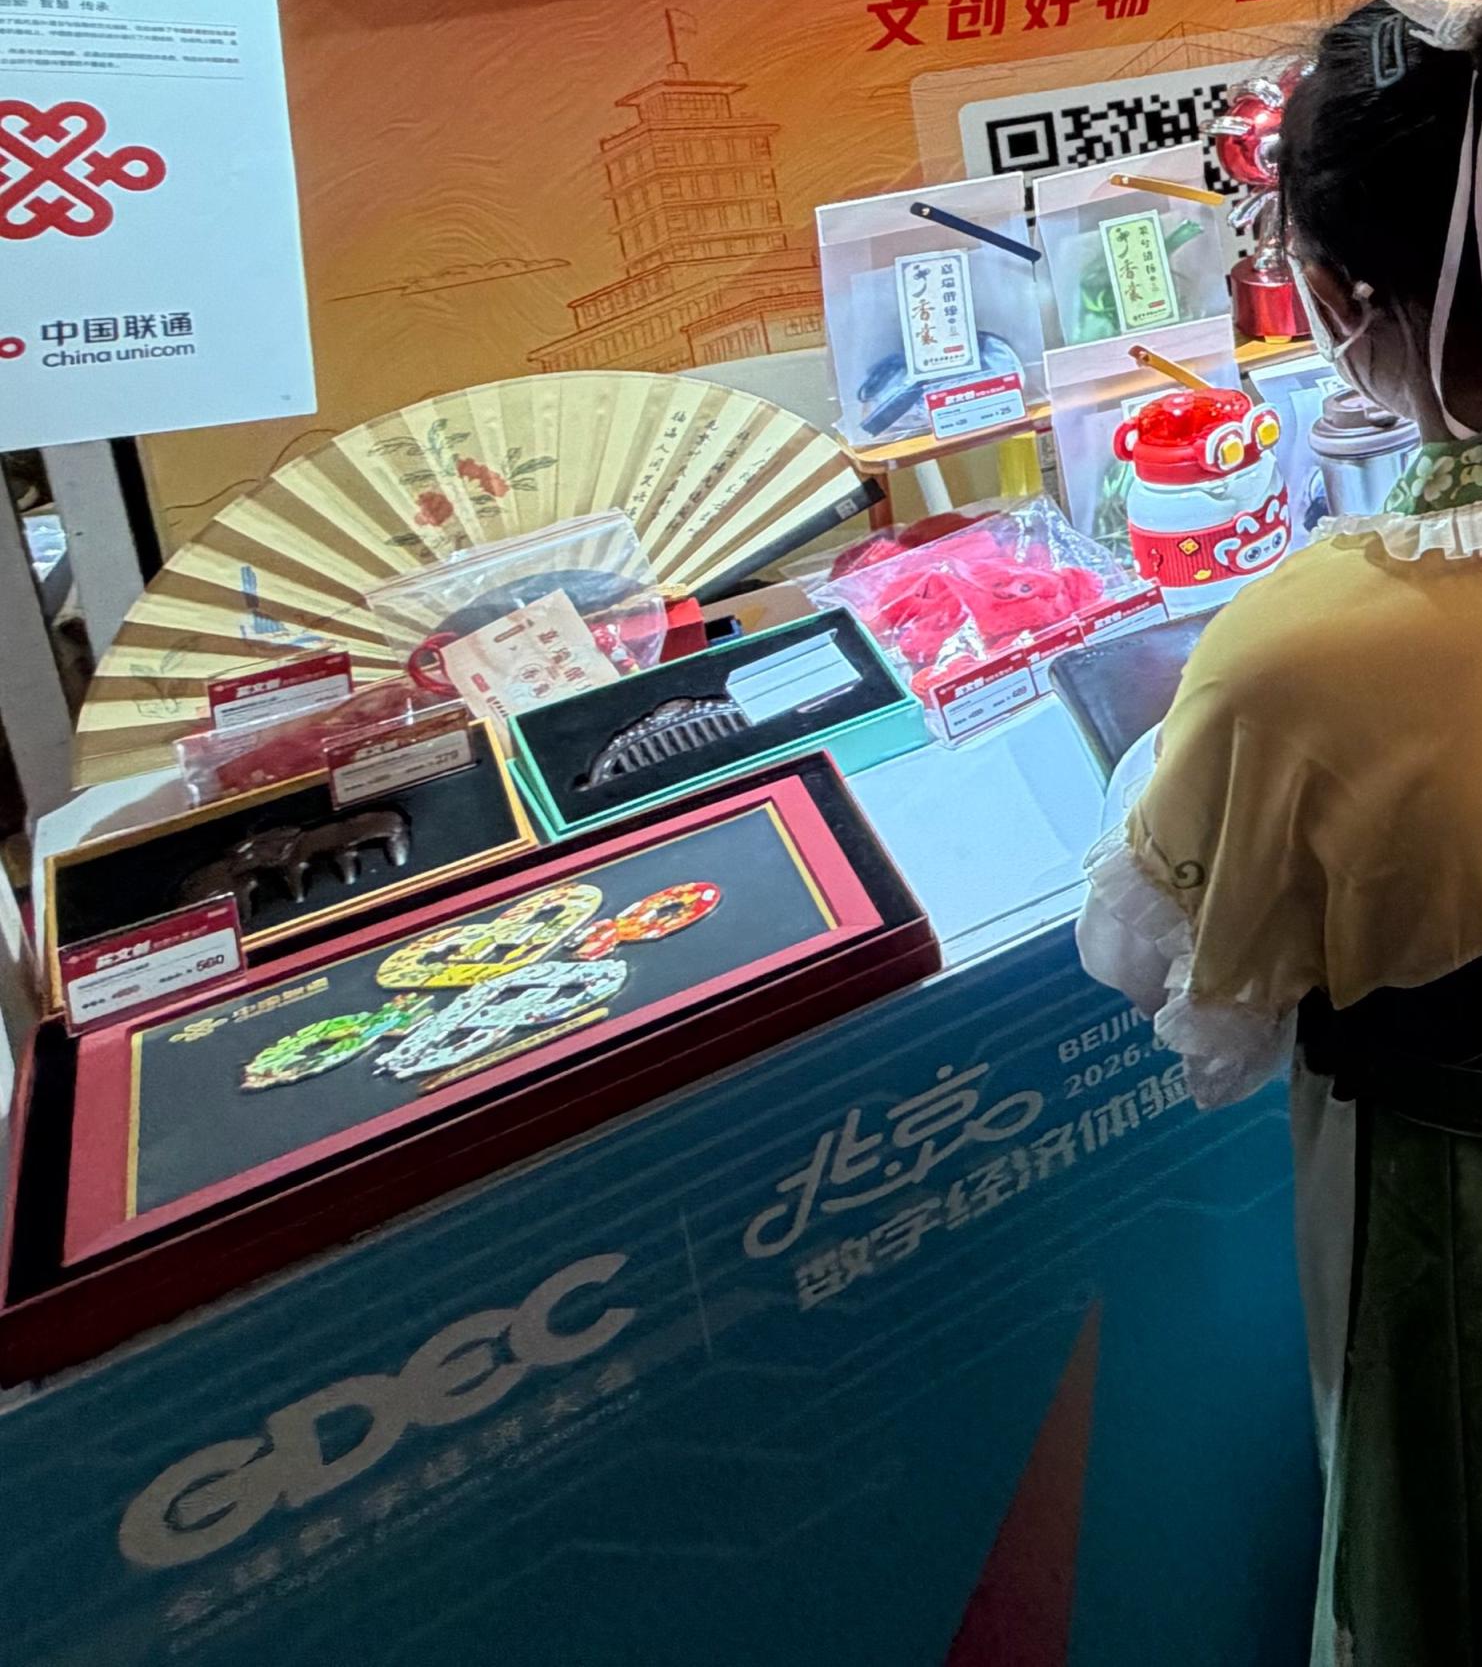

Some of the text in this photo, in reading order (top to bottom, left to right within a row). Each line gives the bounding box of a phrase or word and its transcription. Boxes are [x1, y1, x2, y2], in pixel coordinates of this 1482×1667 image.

[41, 311, 195, 347] 中国联通
[41, 340, 196, 368] China unicom
[1058, 1006, 1151, 1064] BEIJIN
[743, 1063, 1045, 1260] 北京
[796, 1061, 1193, 1311] 数字经济体验
[118, 1252, 636, 1572] GDEC
